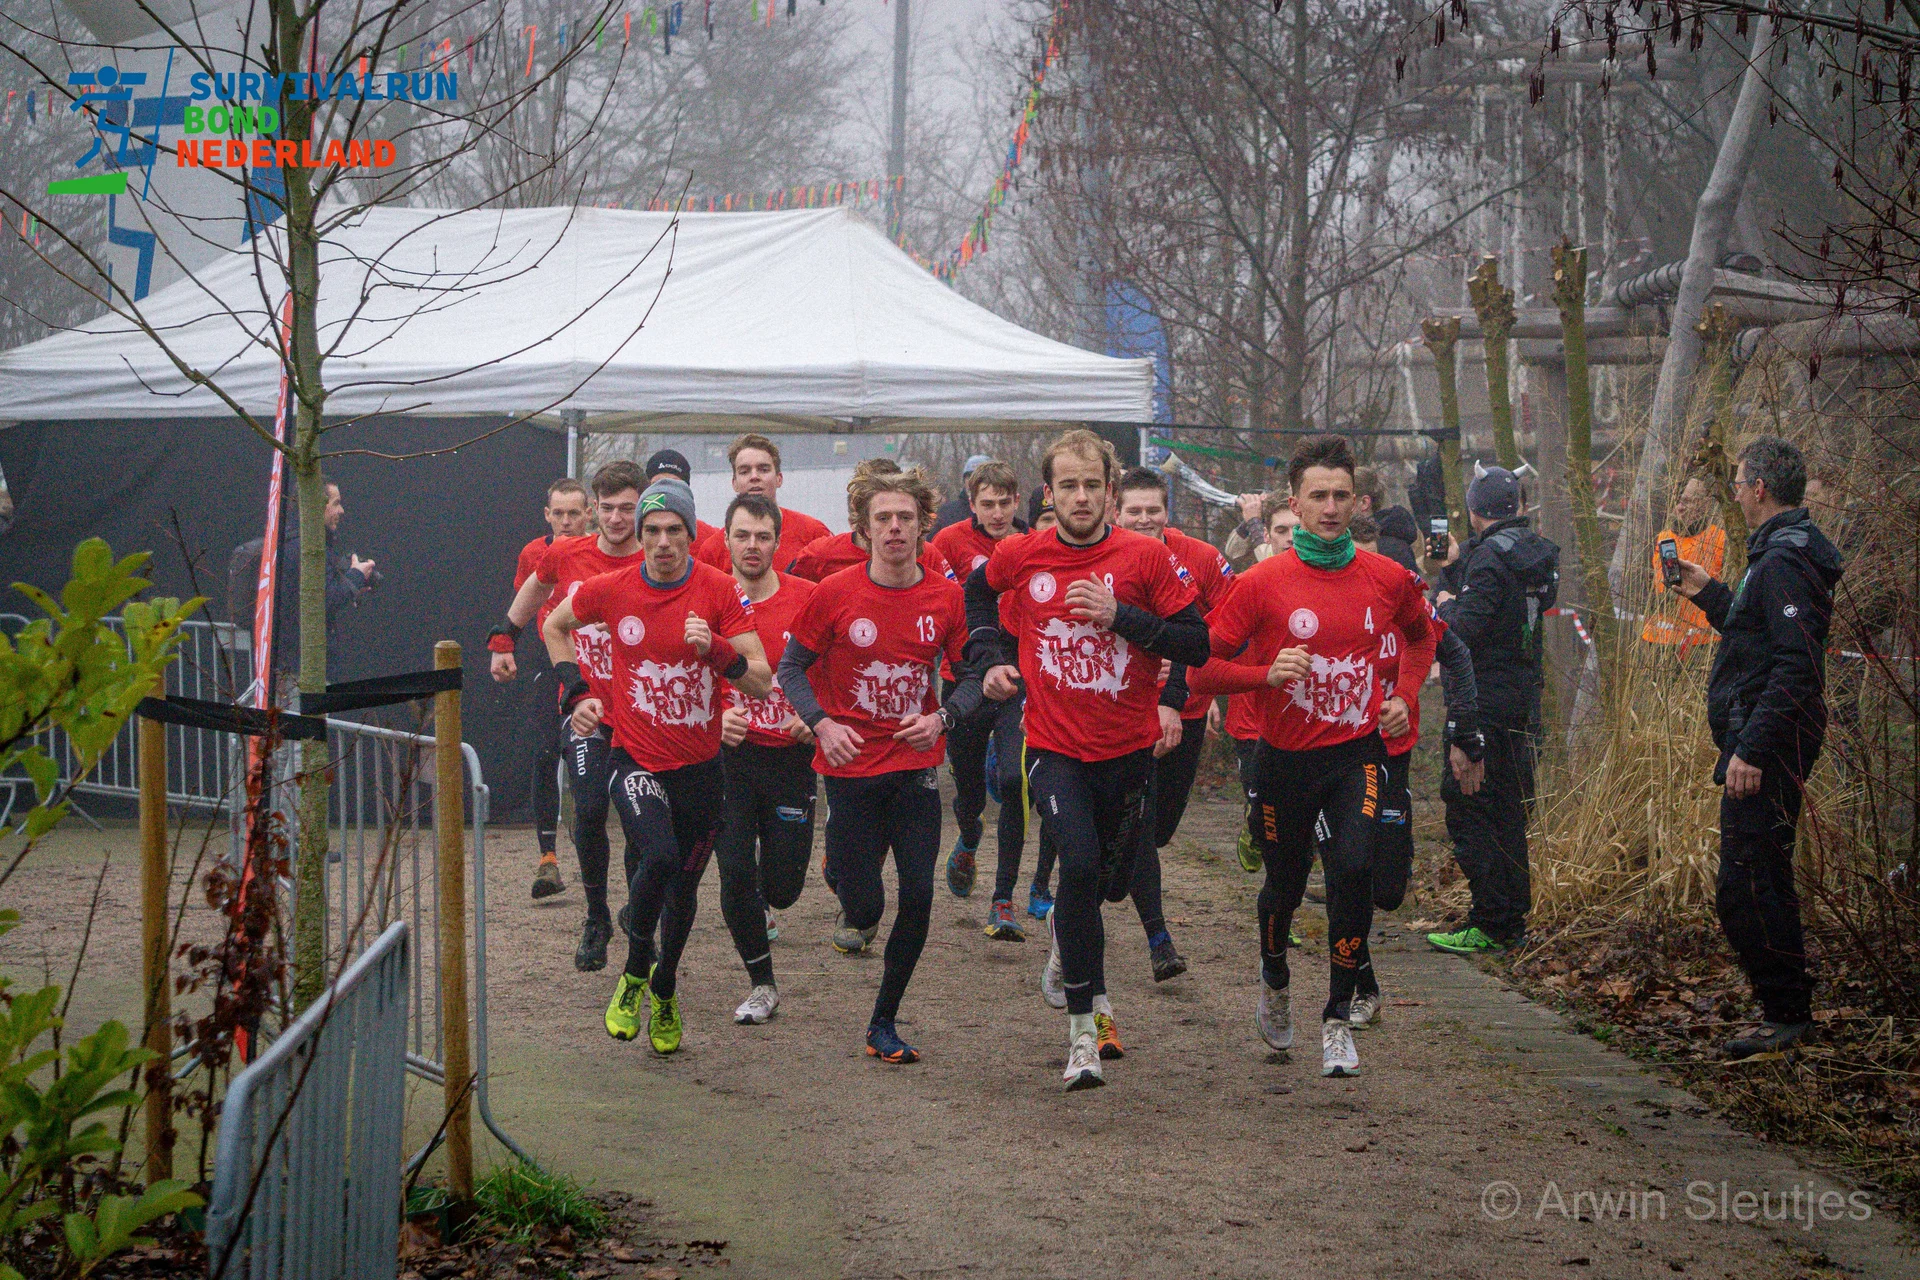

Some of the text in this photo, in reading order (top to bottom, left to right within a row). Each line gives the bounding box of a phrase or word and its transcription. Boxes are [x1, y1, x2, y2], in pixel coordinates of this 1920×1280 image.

[916, 615, 935, 642] 13
[1364, 607, 1374, 634] 4
[1045, 631, 1119, 665] THOR
[1379, 632, 1397, 659] 20
[1056, 654, 1116, 684] RUN
[639, 668, 706, 703] THOR
[863, 668, 924, 702] THOR
[651, 686, 706, 721] RUN
[875, 691, 918, 716] RUN
[1311, 690, 1362, 718] RUN
[576, 741, 589, 776] Timo
